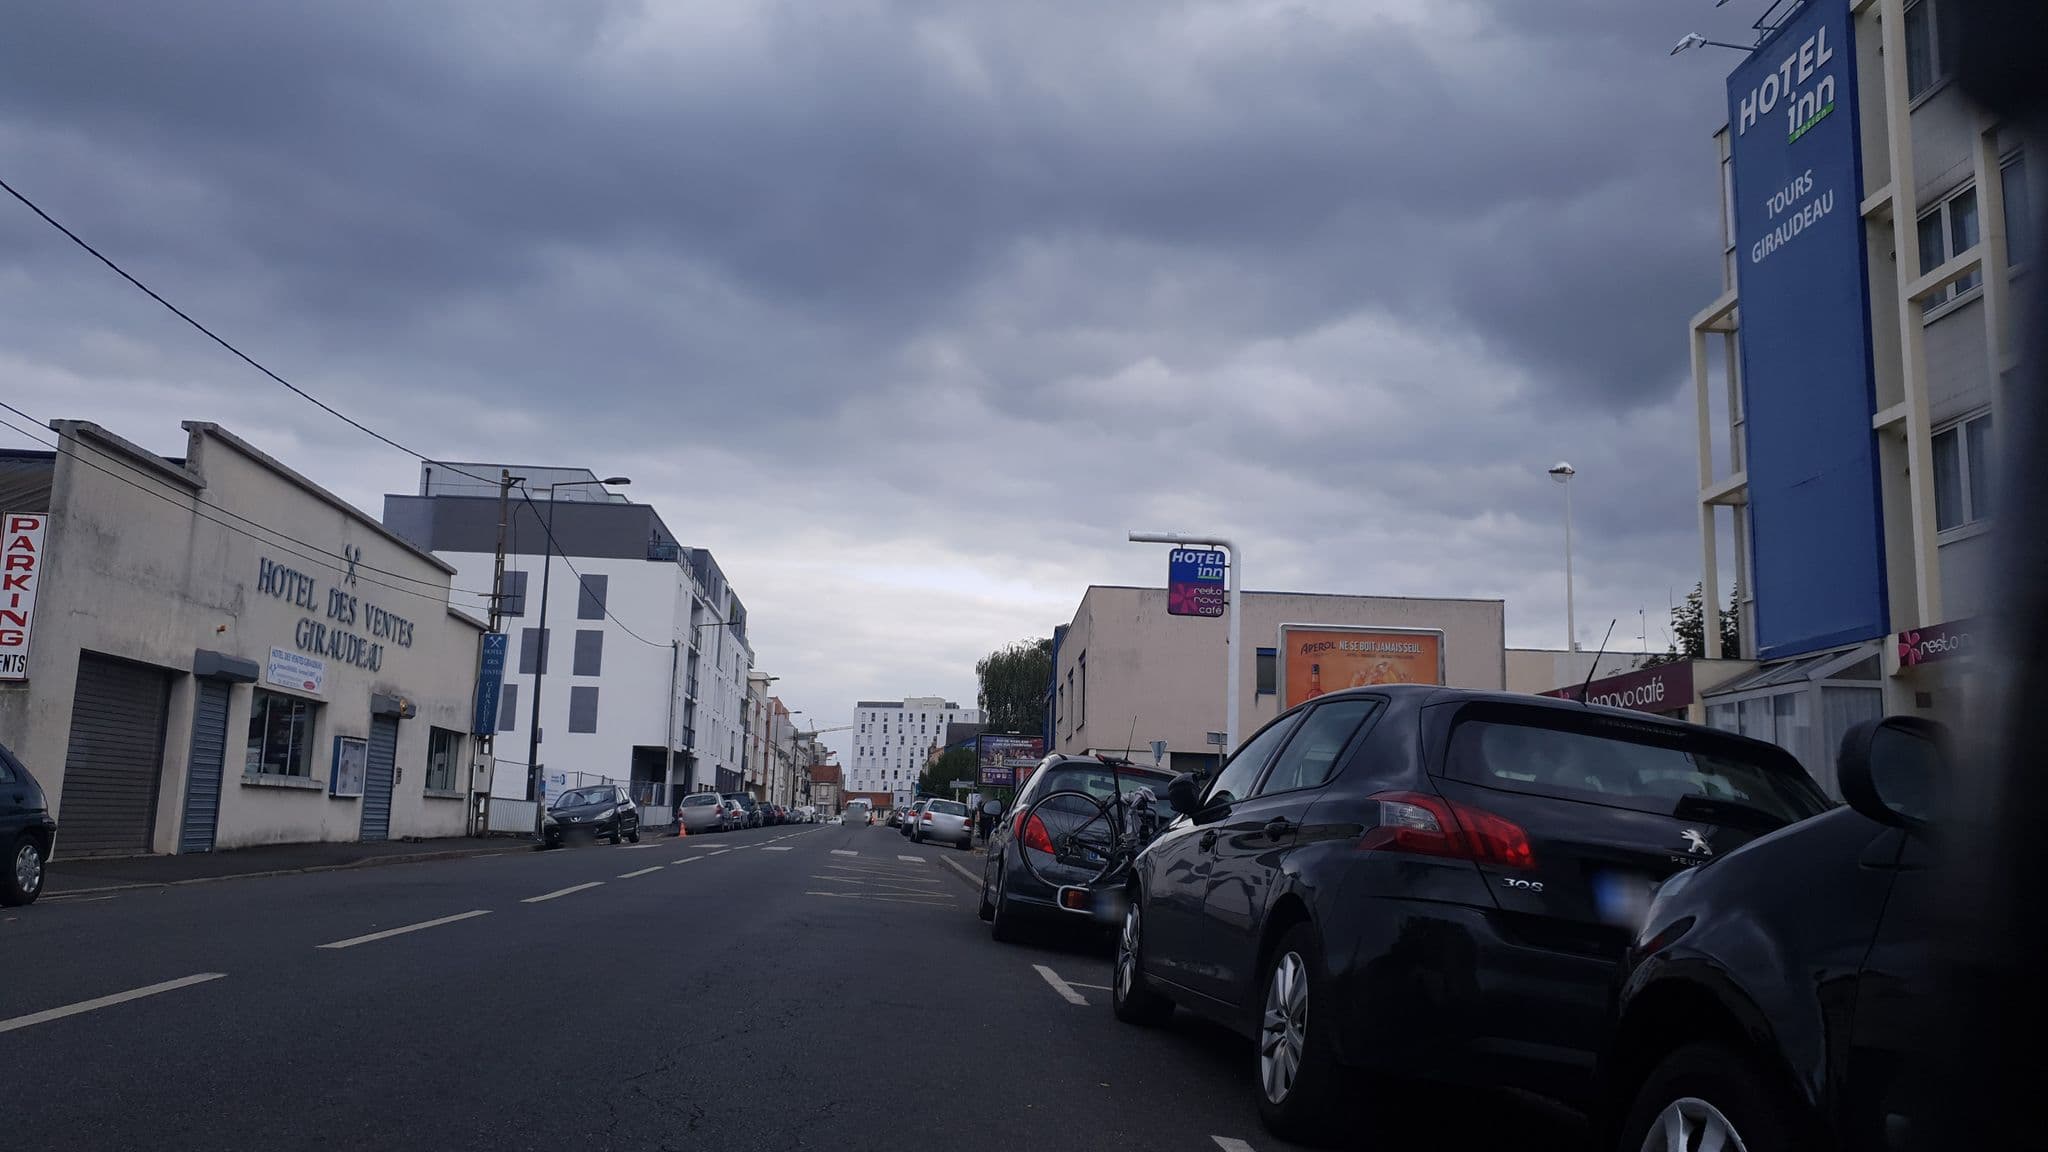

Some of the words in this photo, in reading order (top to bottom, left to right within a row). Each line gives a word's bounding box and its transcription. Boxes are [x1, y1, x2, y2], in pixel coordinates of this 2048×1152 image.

[1740, 25, 1833, 137] HOTEL
[1787, 74, 1835, 135] inn
[1766, 169, 1813, 220] TOURS
[1752, 188, 1834, 264] GIRAUDEAU
[1172, 551, 1223, 565] HOTEL
[1197, 563, 1224, 577] inn
[0, 517, 40, 647] PARKING
[1193, 586, 1222, 596] resto
[257, 556, 318, 613] HOTEL
[327, 587, 358, 627] DES
[365, 602, 415, 649] VENTES
[1193, 596, 1222, 605] novo
[295, 616, 385, 673] GIRAUDEAU
[1339, 640, 1348, 650] NE
[1349, 641, 1359, 651] SE
[1359, 642, 1376, 651] BOIT
[1376, 642, 1404, 653] JAMAIS
[1920, 632, 1959, 656] resto
[1600, 690, 1635, 708] novo
[1635, 675, 1665, 704] café
[1503, 877, 1545, 893] 308
